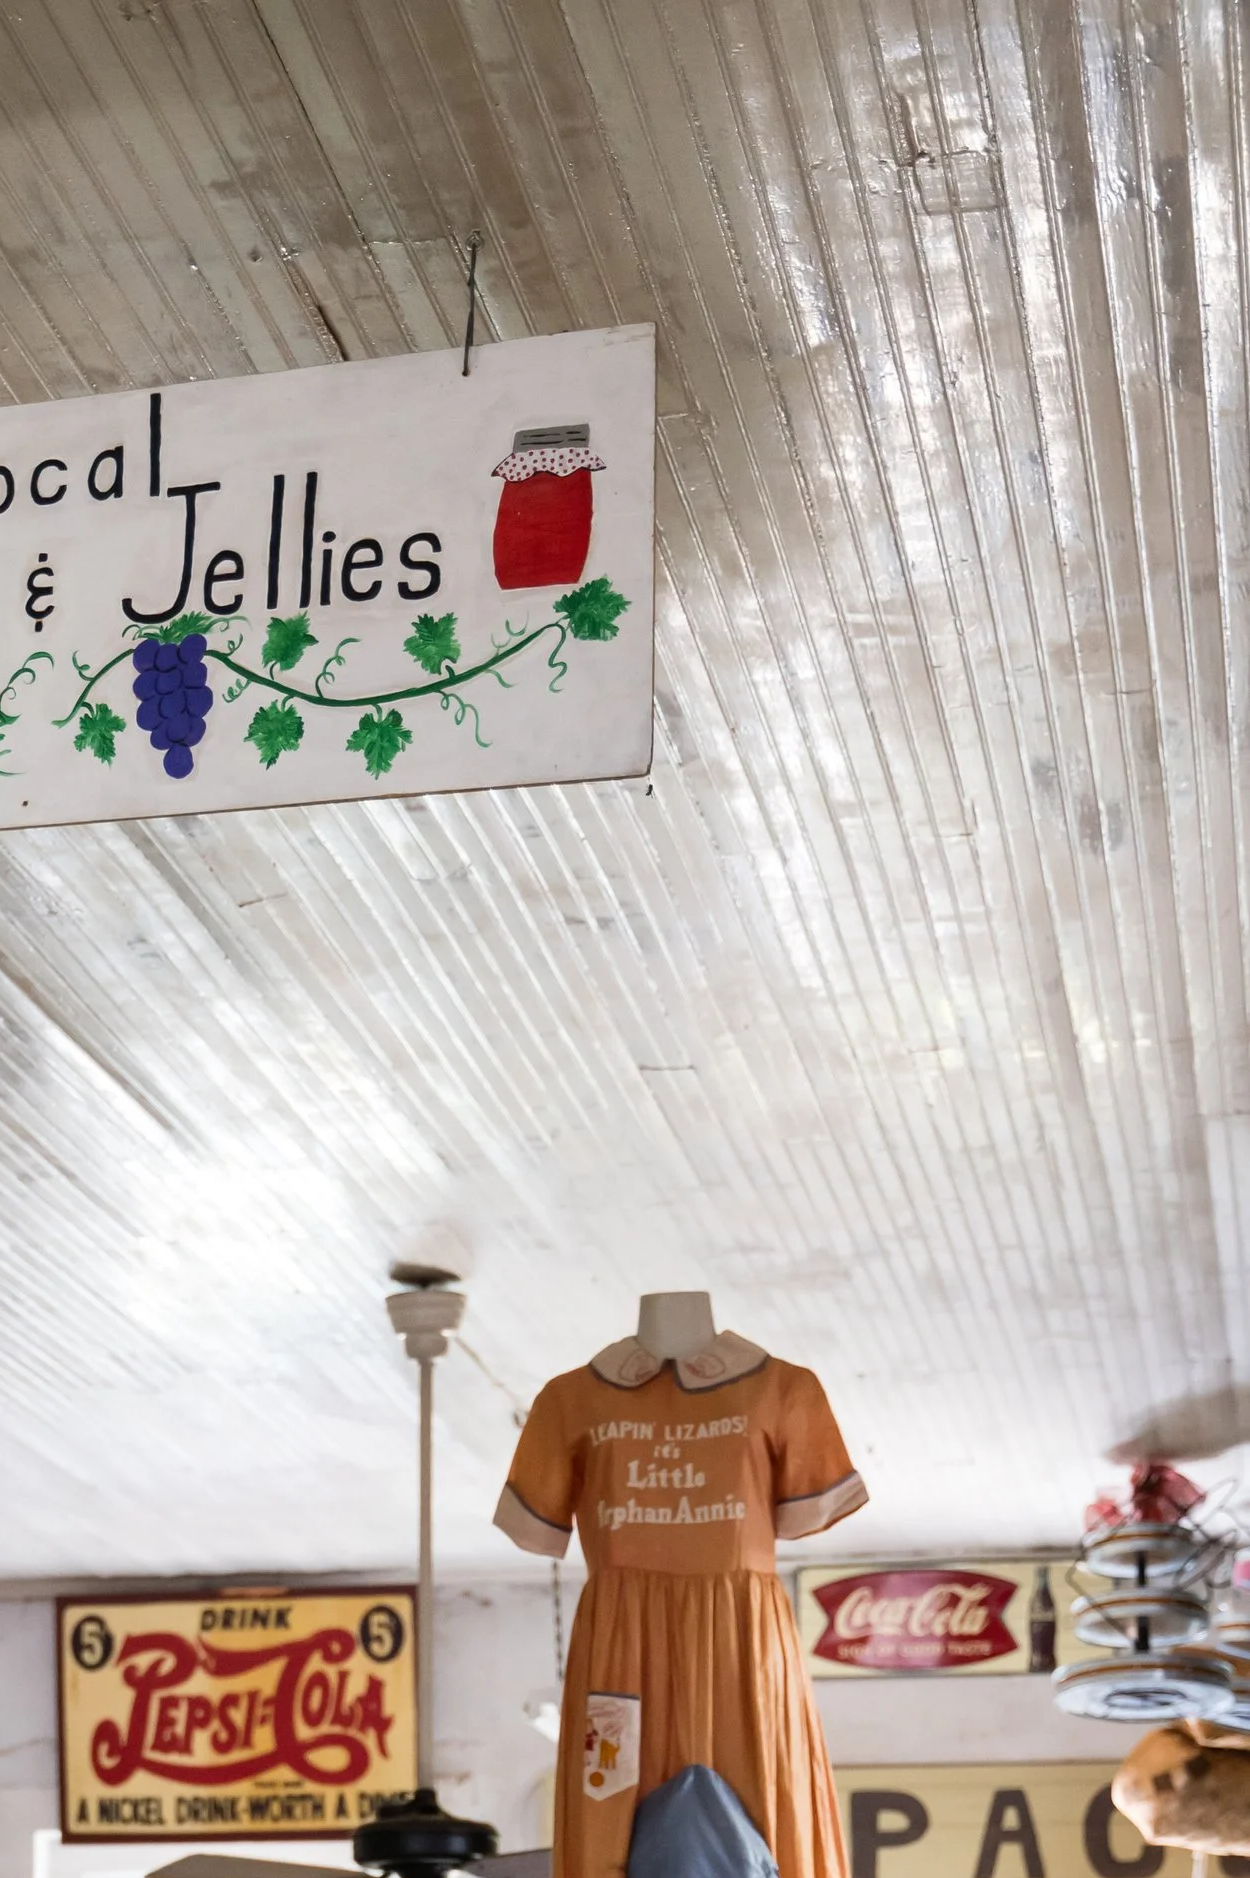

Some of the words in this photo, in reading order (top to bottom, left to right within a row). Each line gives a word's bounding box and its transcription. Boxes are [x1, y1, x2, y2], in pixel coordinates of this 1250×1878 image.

[25, 551, 55, 633] &
[122, 471, 444, 626] Jellies
[627, 1459, 706, 1490] Little
[675, 1493, 746, 1524] Annie
[199, 1607, 293, 1632] DRINK
[77, 1798, 90, 1823] A
[99, 1796, 166, 1826] NICKEL
[336, 1793, 347, 1819] A
